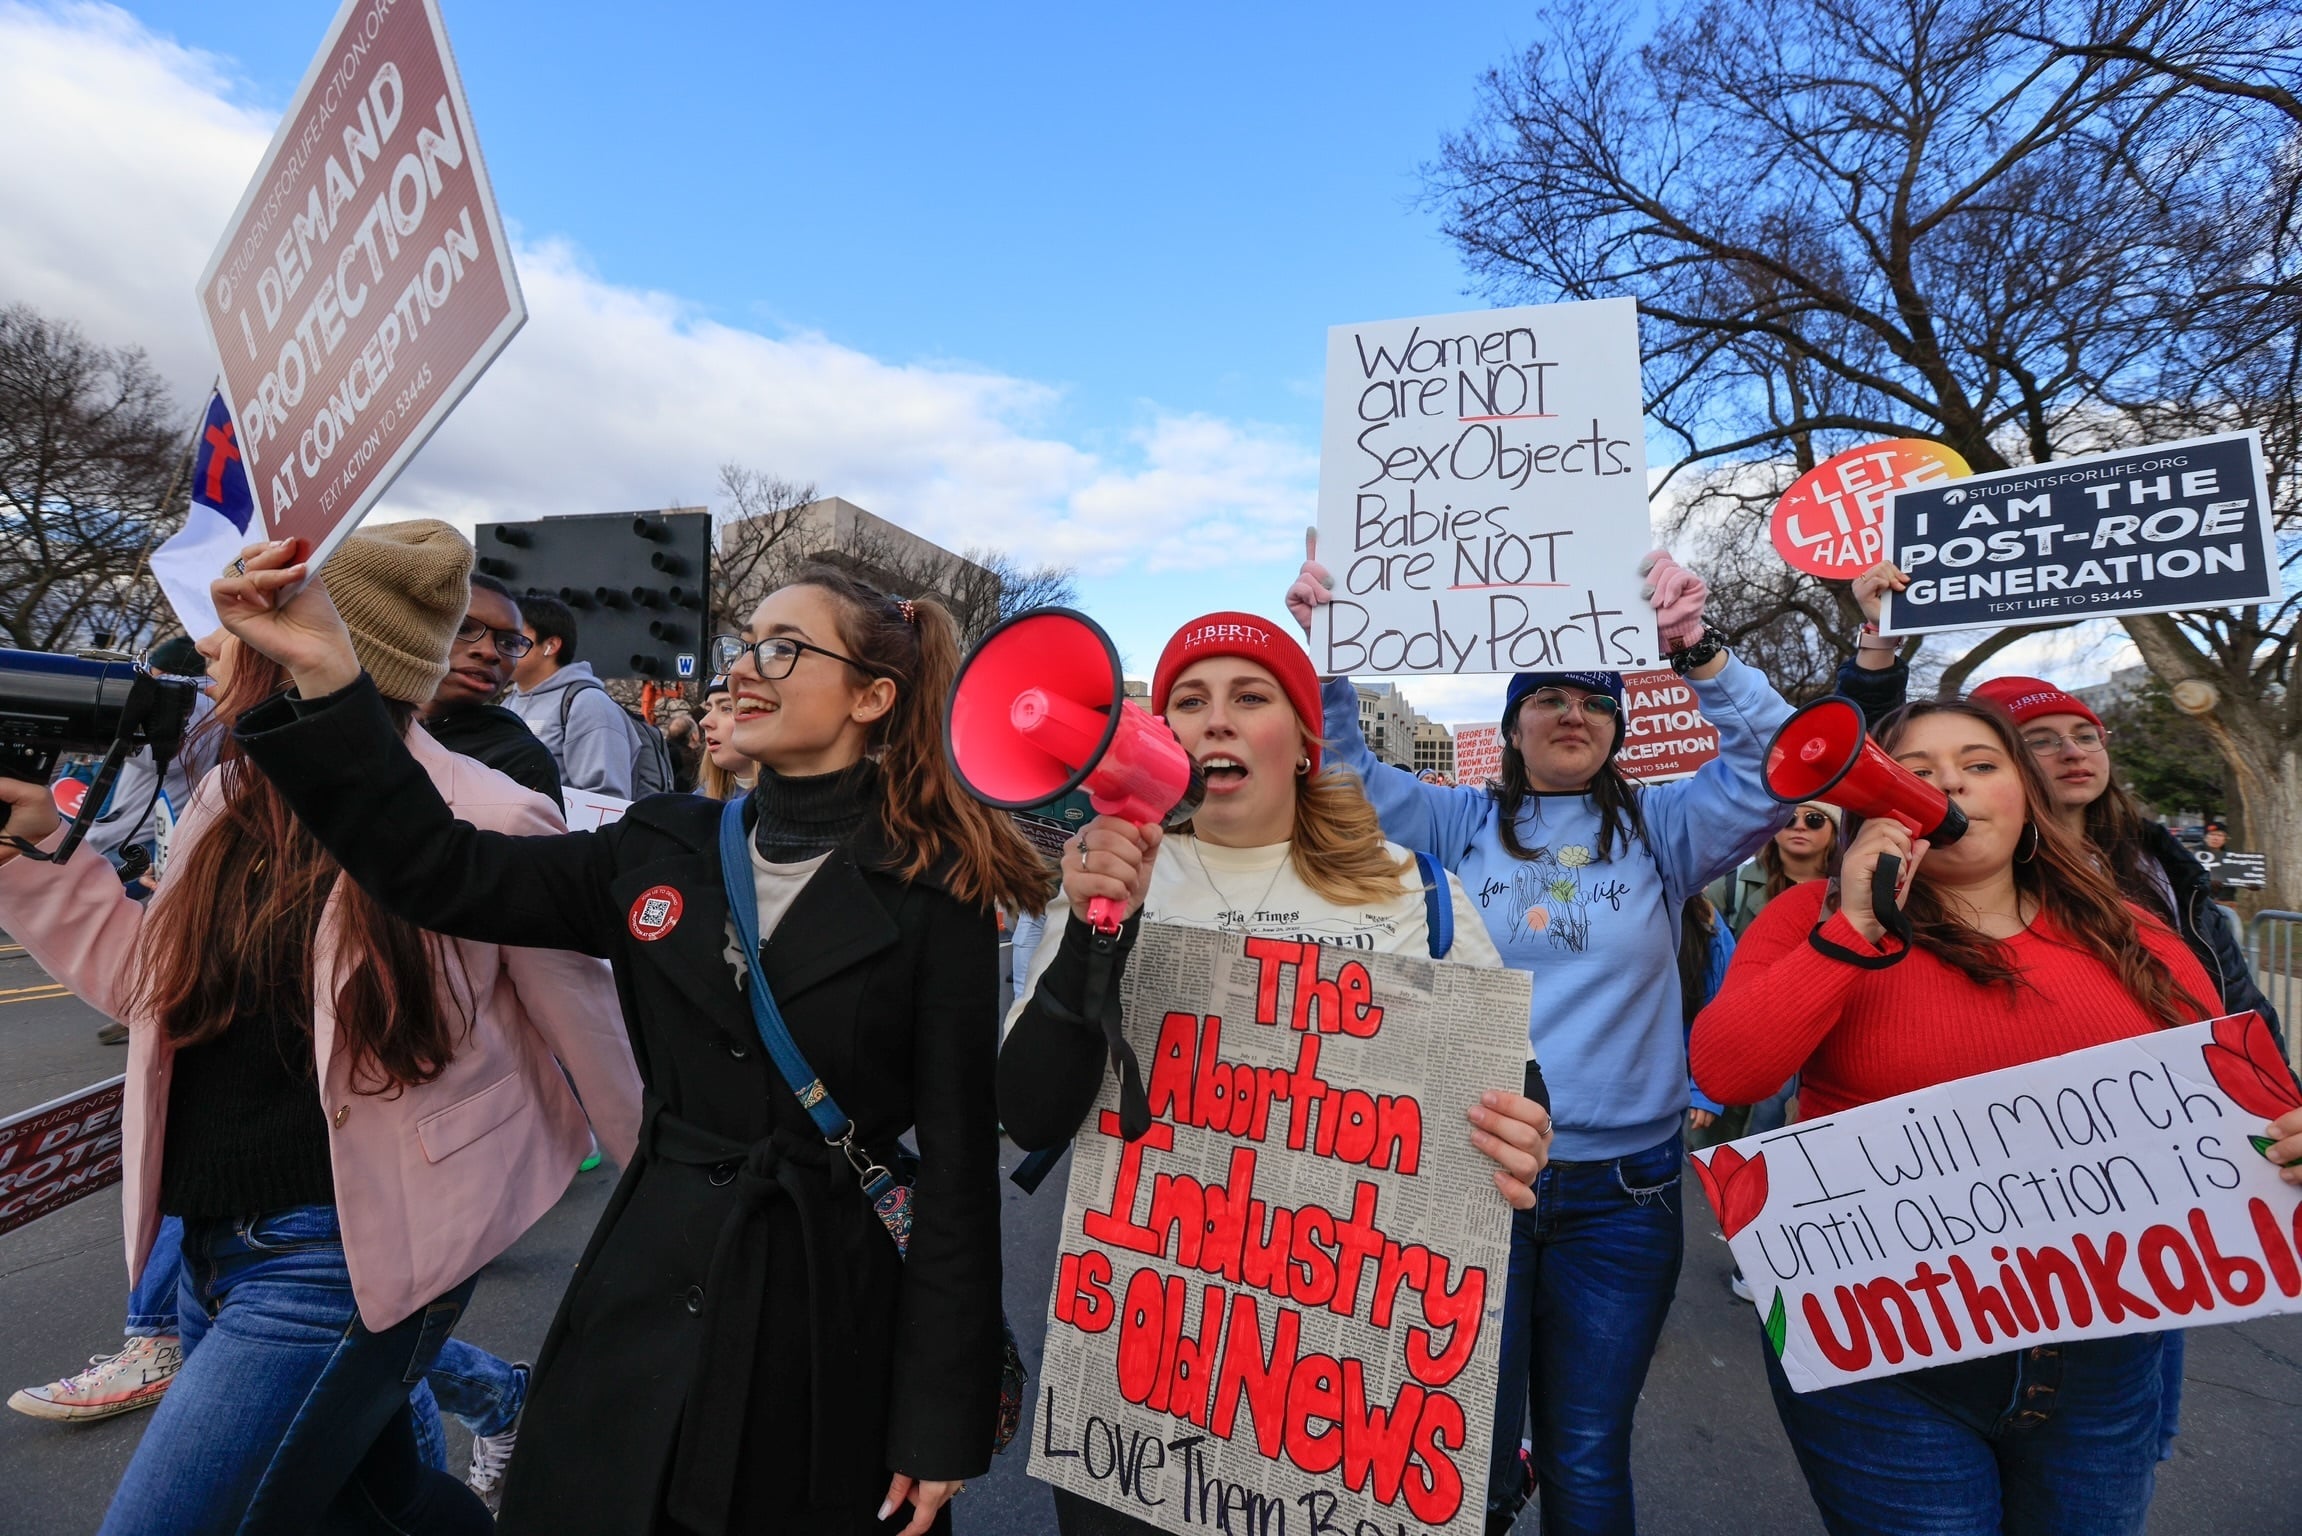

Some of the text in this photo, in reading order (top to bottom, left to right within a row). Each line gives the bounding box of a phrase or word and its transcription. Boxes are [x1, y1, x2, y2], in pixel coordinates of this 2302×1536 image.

[230, 0, 396, 289] STUDENTSFORLIFEACTION.OR
[240, 61, 404, 361] I DEMAND
[242, 94, 463, 466] PROTECTION
[271, 206, 480, 525] AT CONCEPTION
[1355, 326, 1537, 379] Women
[1358, 362, 1559, 422] are NOT
[319, 362, 433, 515] TEXT ACTION TO 53445
[1449, 418, 1632, 490] Objects.
[1810, 451, 1898, 505] LET
[1916, 468, 2220, 537] I AM THE
[1969, 456, 2189, 500] STUDENTSFORLIFE.ORG
[1354, 489, 1510, 552] Babies
[1812, 523, 1882, 567] HAP
[1900, 498, 2250, 574] POST-ROE
[1346, 531, 1574, 596] are NOT
[1905, 543, 2246, 606] GENERATION
[1327, 590, 1648, 674] Body Parts.
[1988, 589, 2143, 613] TEXT LIFE TO 53445
[679, 658, 693, 673] W
[1185, 624, 1271, 644] LIBERTY
[1565, 673, 1596, 686] AMERICA
[1457, 728, 1497, 740] BEFORE THE
[1457, 738, 1493, 749] WOMB YOU
[1457, 749, 1475, 758] WERE
[1655, 761, 1680, 770] 53445
[1458, 769, 1472, 777] AND
[1254, 911, 1300, 924] Times
[1479, 876, 1511, 908] for
[1593, 880, 1631, 911] life
[1245, 936, 1384, 1038] The
[1148, 1012, 1423, 1176] Abortion
[1760, 1062, 2222, 1208] I will march
[0, 1153, 123, 1218] CONC
[1755, 1135, 2241, 1280] until abortion is
[1083, 1109, 1486, 1388] Industry
[154, 1346, 182, 1366] PR
[1117, 1267, 1226, 1429] Old
[1167, 1435, 1286, 1536] Them
